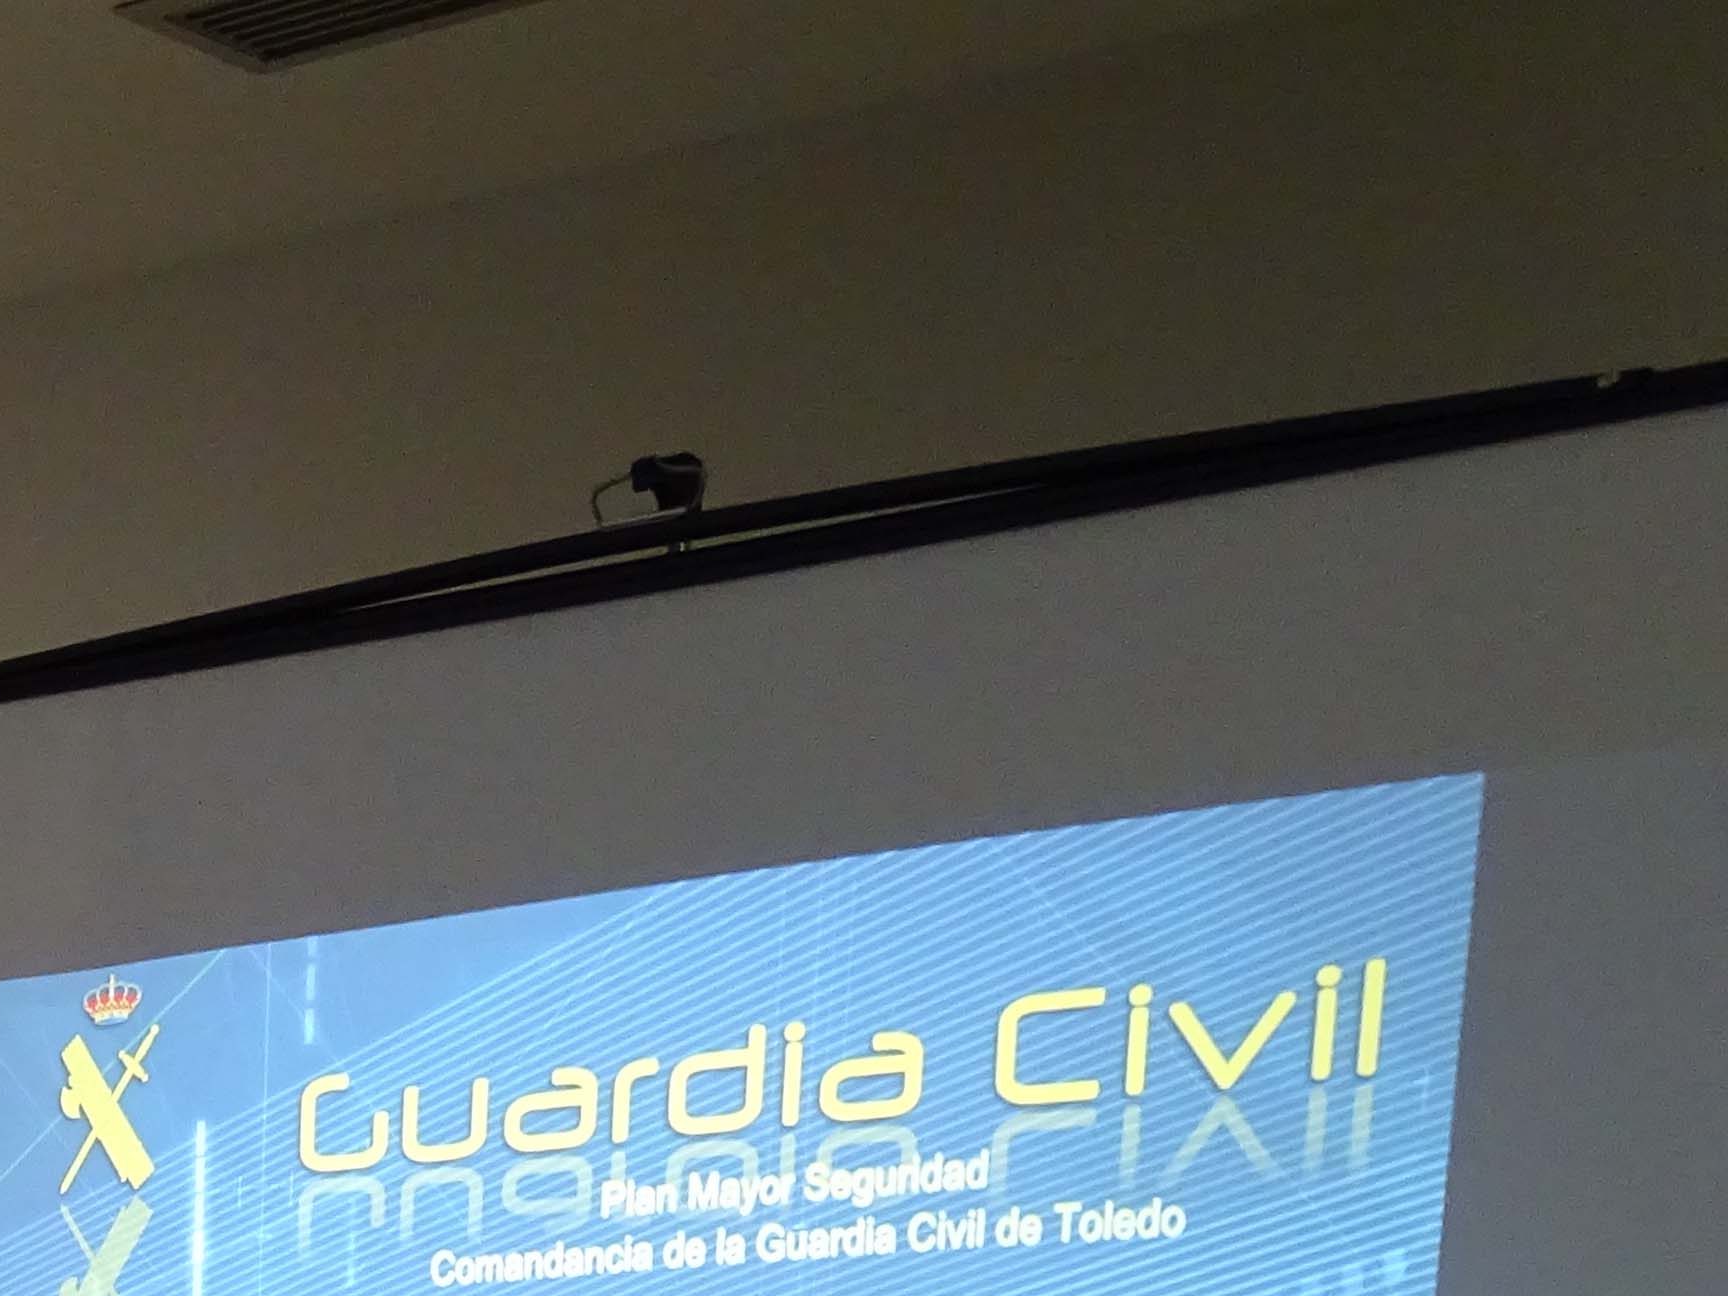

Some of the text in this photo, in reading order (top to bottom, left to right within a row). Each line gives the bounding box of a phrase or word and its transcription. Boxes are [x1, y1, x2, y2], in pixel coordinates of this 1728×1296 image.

[298, 1020, 925, 1173] Guardia
[994, 957, 1387, 1107] Civil
[600, 1178, 683, 1221] Plan
[687, 1167, 794, 1219] Mayor
[802, 1149, 990, 1208] Seguridad
[430, 1197, 1187, 1288] Comandancia de la Guardia Civil de Toledo
